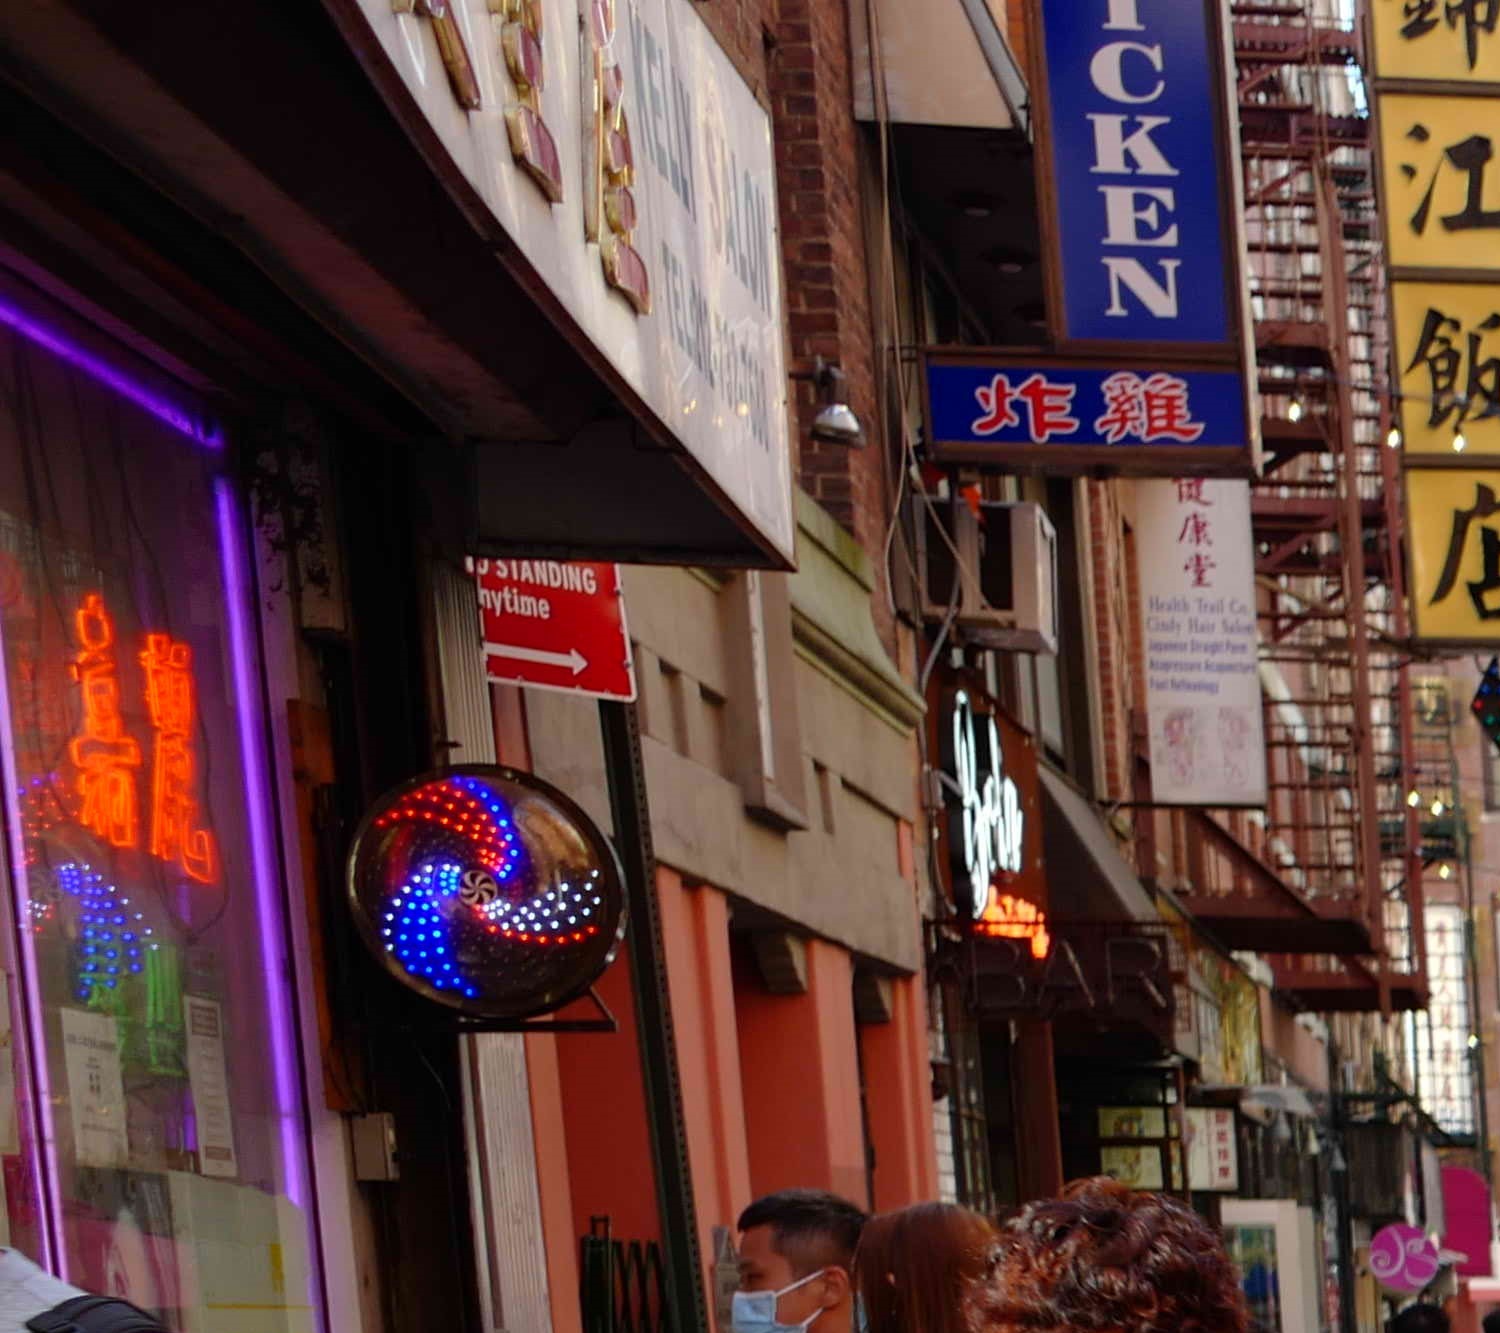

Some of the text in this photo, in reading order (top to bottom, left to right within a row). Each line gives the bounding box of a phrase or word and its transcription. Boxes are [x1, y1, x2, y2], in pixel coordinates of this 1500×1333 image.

[973, 370, 1204, 444] 炸雞
[496, 559, 598, 595] STANDING
[480, 586, 550, 620] nytime
[1149, 598, 1190, 616] Health
